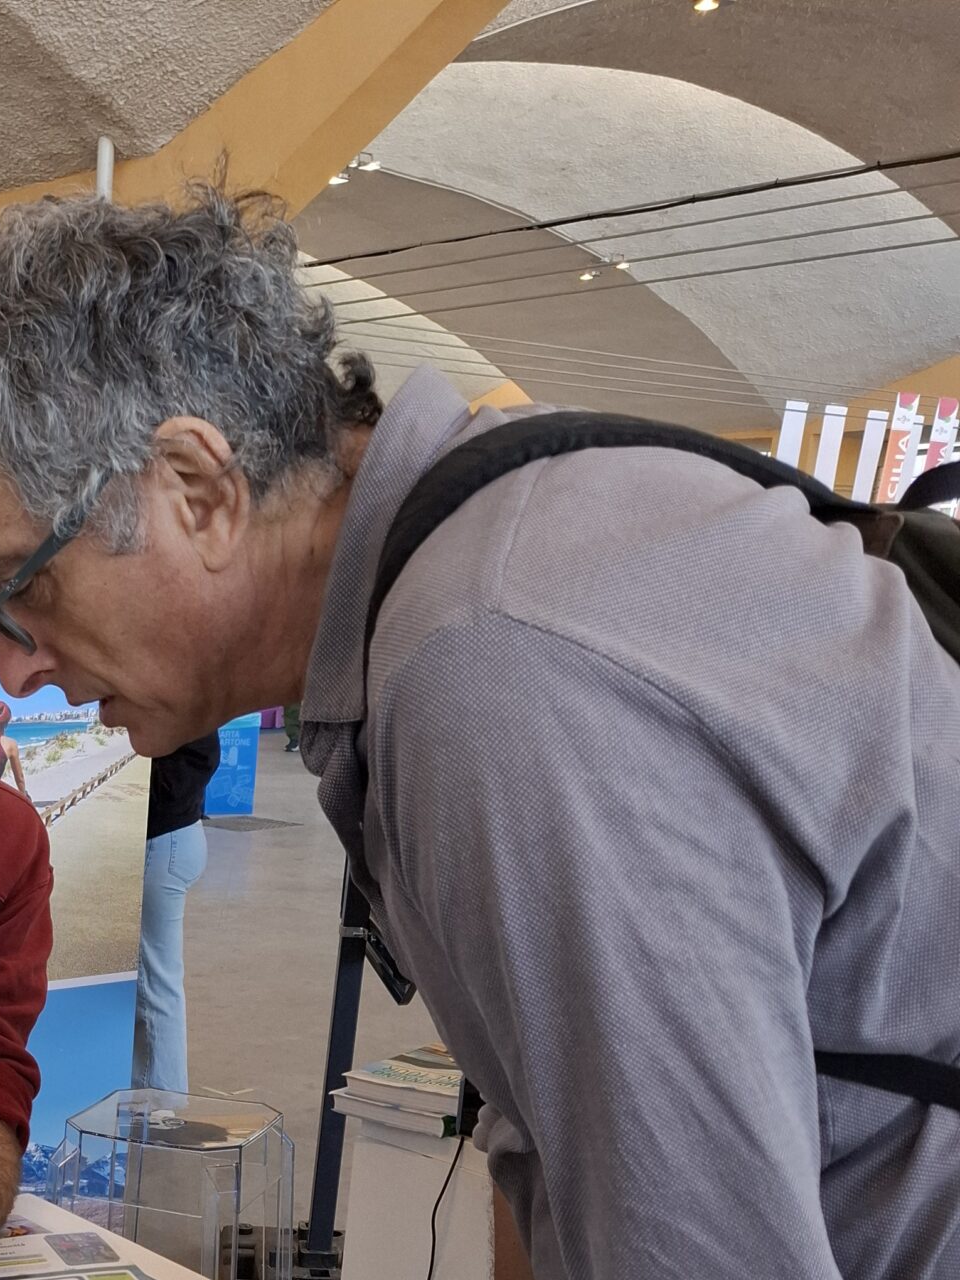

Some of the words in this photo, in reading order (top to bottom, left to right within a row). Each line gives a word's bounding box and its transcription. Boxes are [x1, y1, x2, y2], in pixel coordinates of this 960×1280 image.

[886, 434, 912, 504] CILIA
[220, 730, 240, 738] ARTA
[220, 738, 251, 746] ARTONE
